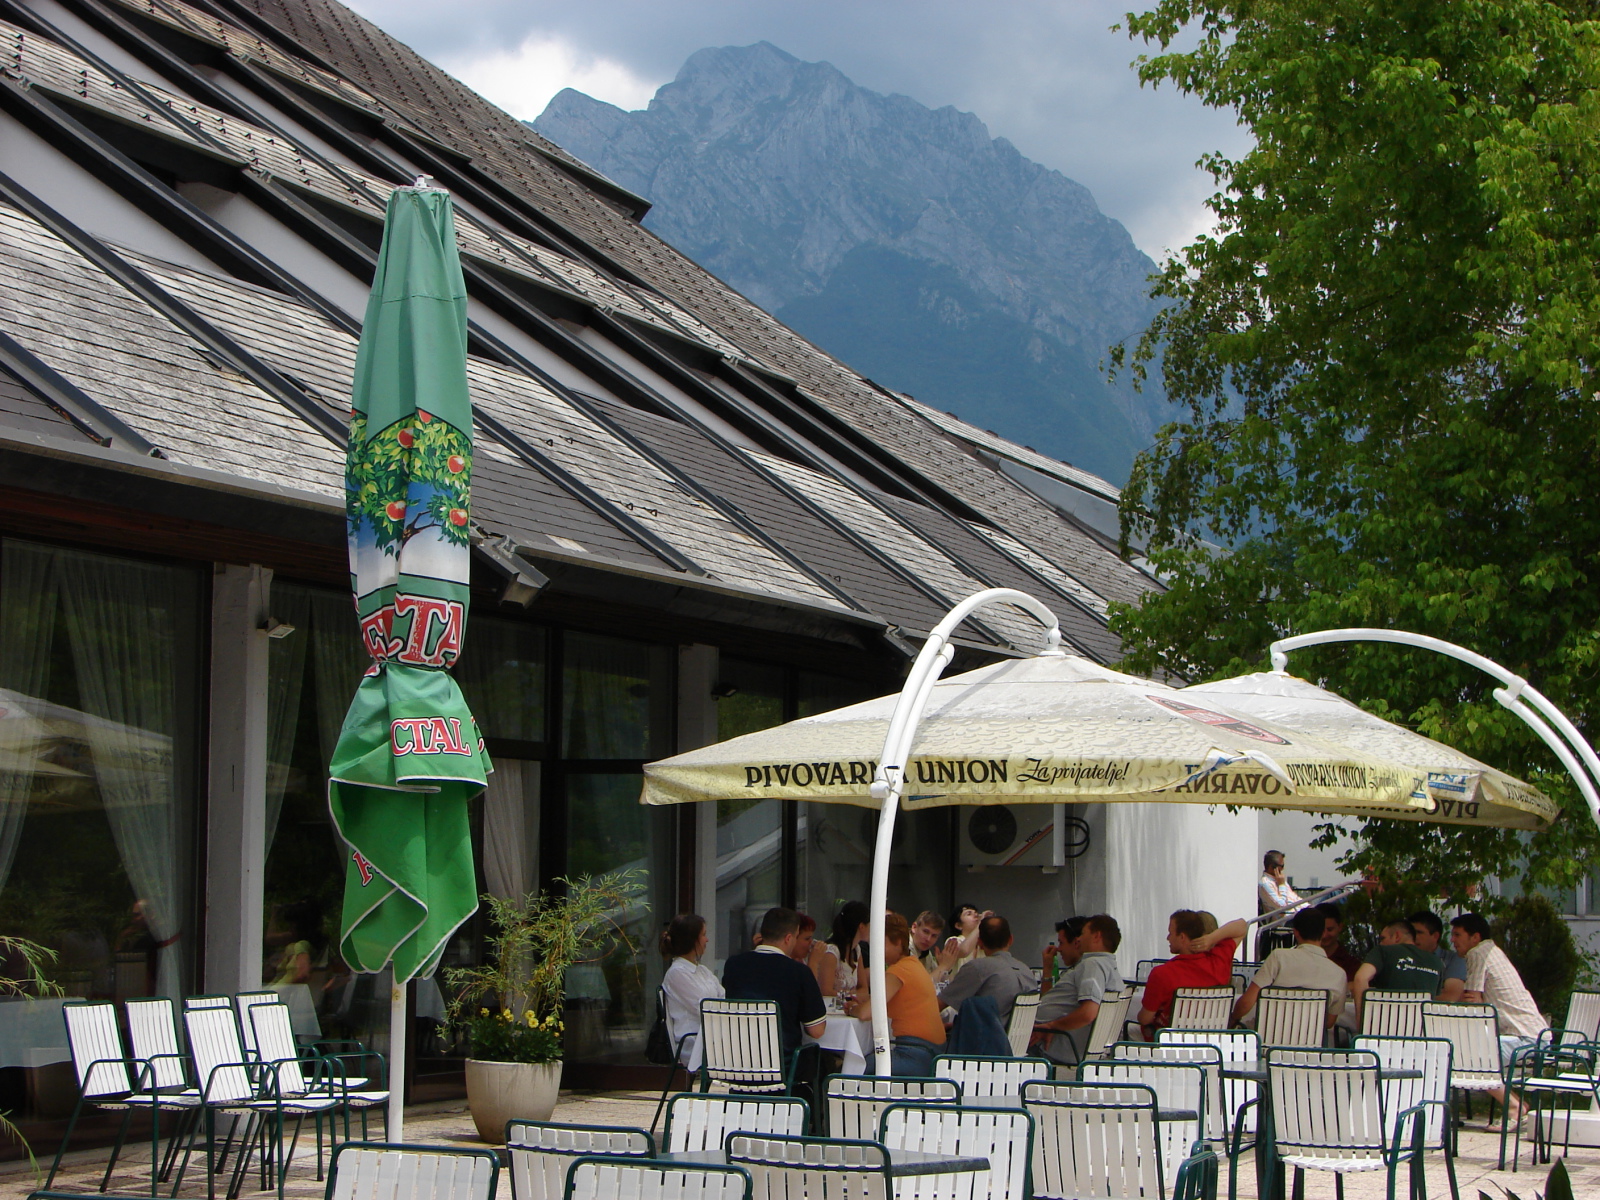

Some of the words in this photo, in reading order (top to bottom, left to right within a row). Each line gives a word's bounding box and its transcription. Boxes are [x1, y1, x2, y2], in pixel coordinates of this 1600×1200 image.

[391, 717, 472, 757] CTAL
[745, 760, 909, 788] PIVOVAR
[915, 759, 1008, 784] UNION
